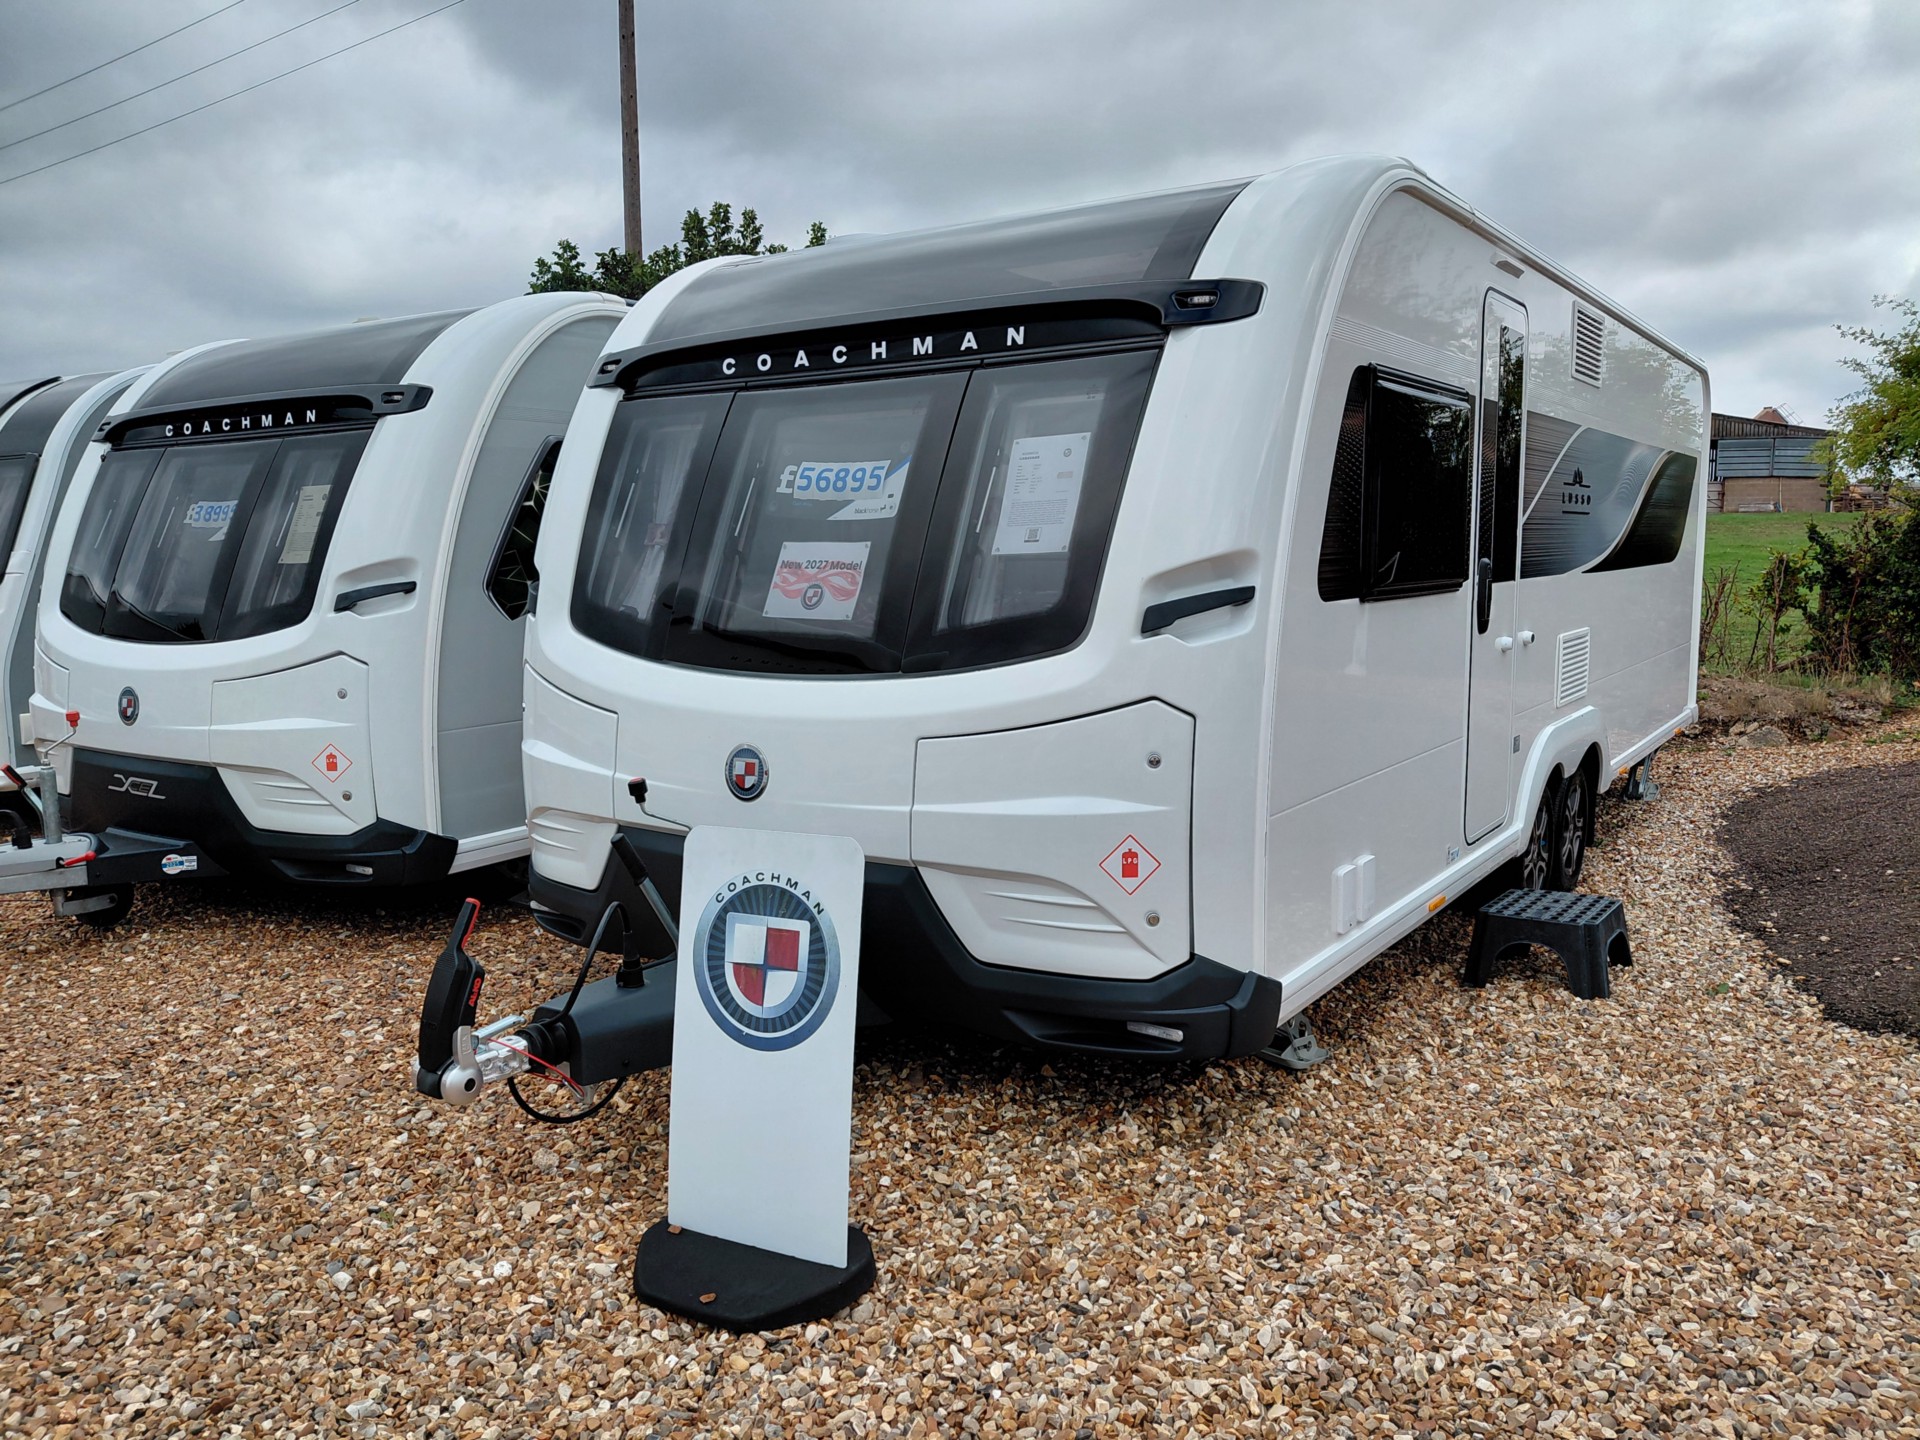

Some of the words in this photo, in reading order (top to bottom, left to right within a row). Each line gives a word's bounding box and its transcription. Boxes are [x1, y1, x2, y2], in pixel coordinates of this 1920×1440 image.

[722, 326, 1025, 375] COACHMAN
[165, 409, 316, 437] COACHMAN
[776, 464, 886, 494] £56895
[1562, 491, 1591, 505] LUSSO
[780, 560, 804, 570] New
[829, 560, 863, 571] Model
[1122, 857, 1138, 865] LPG
[715, 872, 825, 915] COACHMAN
